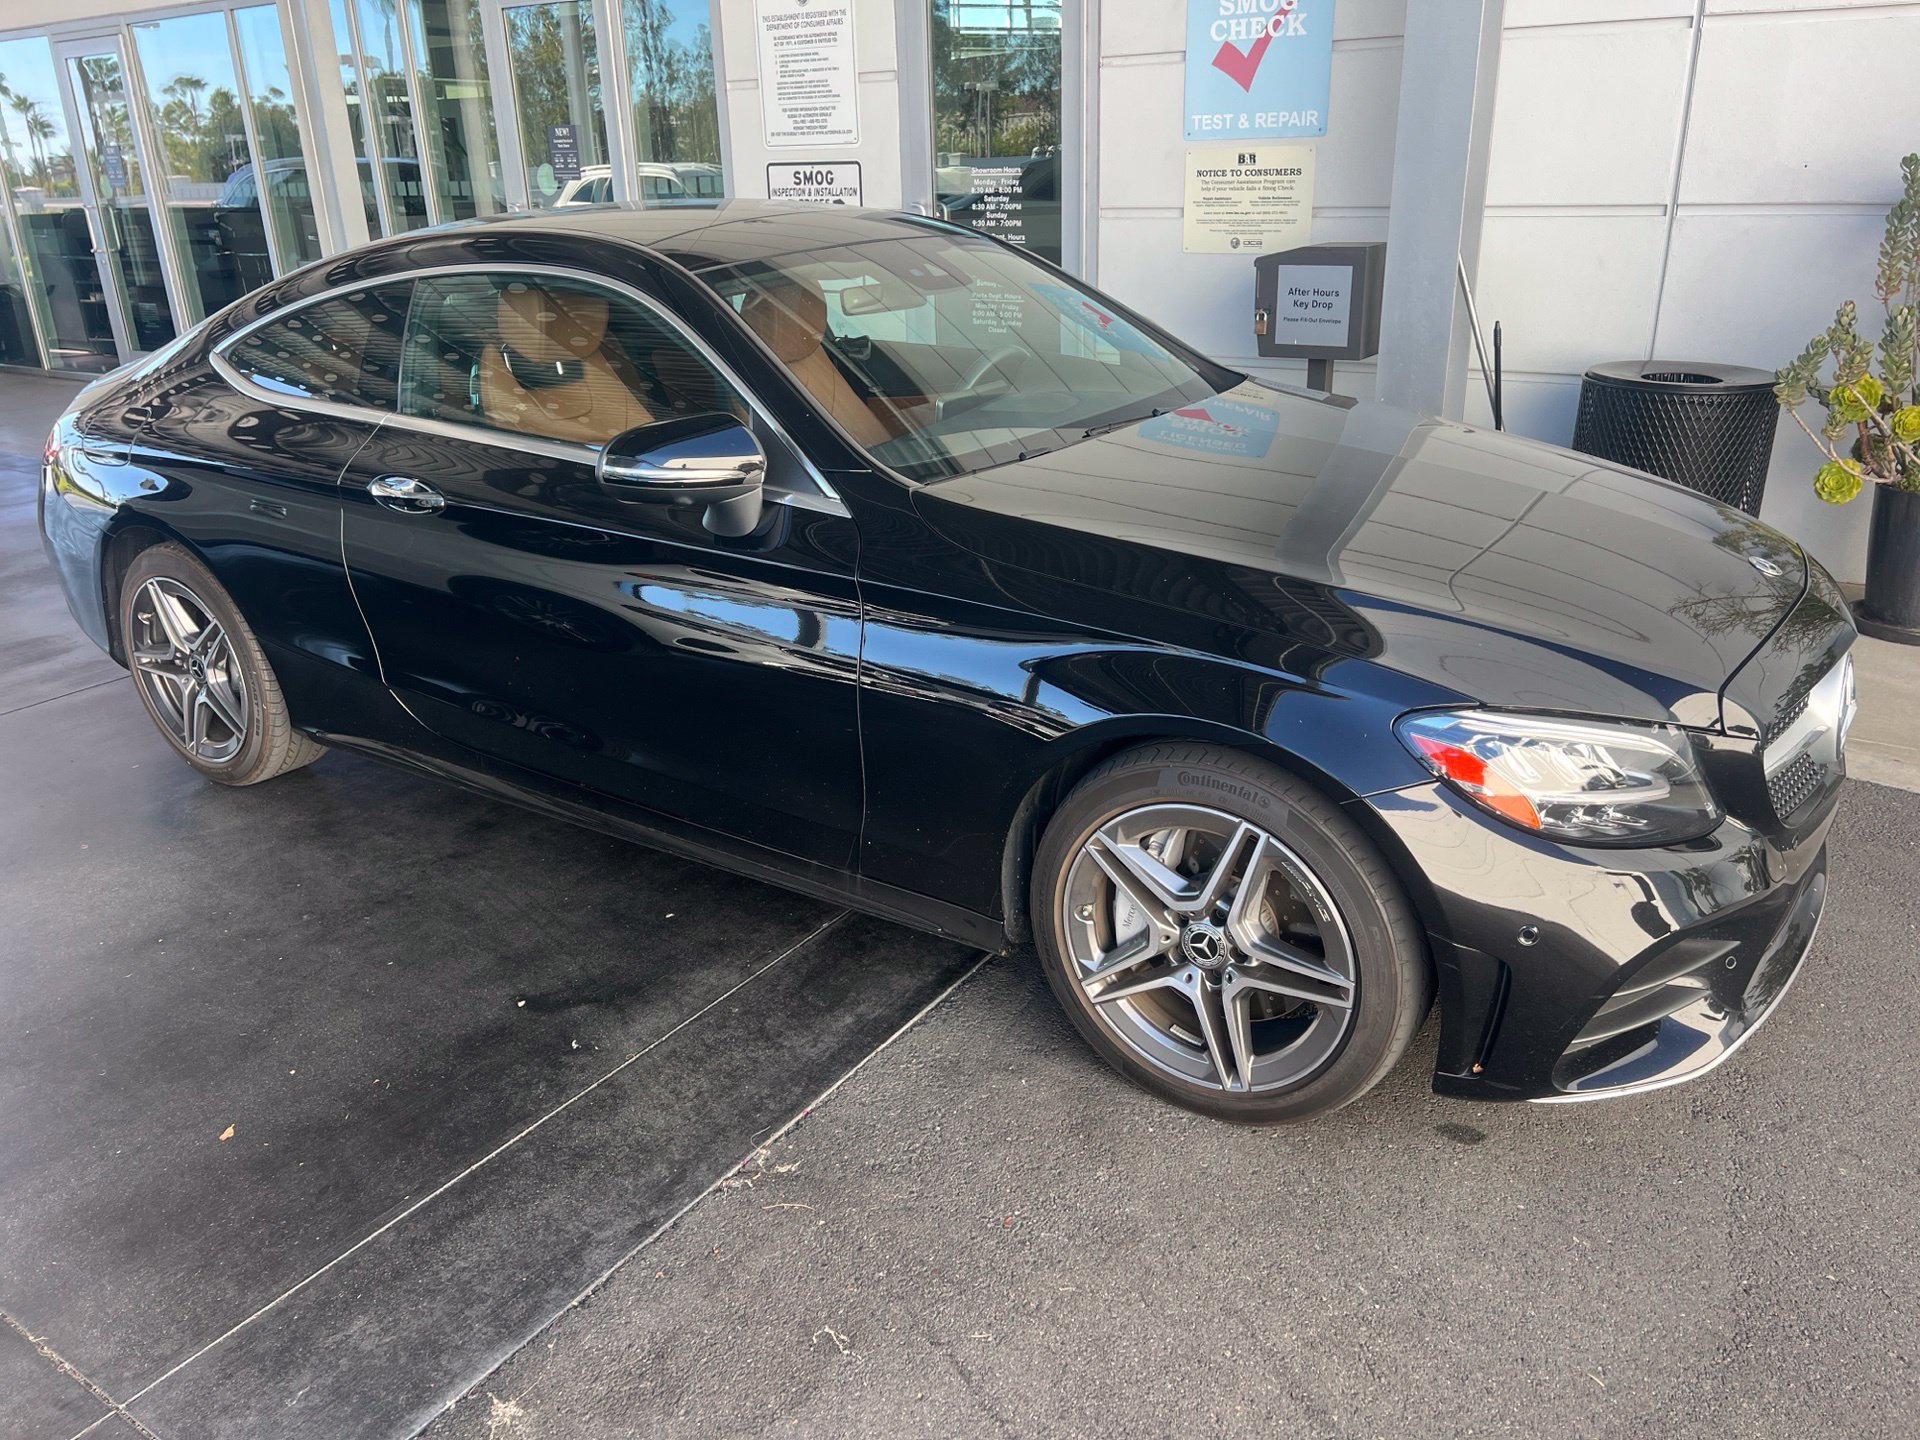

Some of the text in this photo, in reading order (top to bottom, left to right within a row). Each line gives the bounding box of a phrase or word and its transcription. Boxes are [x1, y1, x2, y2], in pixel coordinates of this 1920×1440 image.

[771, 13, 800, 22] ESTABLISHMENT
[805, 11, 827, 19] REGISTERED
[766, 23, 793, 31] DEPARTMENT
[801, 20, 825, 28] CONSUMER
[1210, 13, 1307, 41] CHECK
[1192, 110, 1318, 130] TEST & REPAIR
[793, 170, 834, 186] SMOG
[1245, 168, 1302, 177] CONSUMERS
[772, 187, 857, 197] INSPECTION & INSTALLATION
[1288, 287, 1340, 297] After Hours
[1293, 300, 1333, 310] Key Drop
[1177, 771, 1258, 802] Continental
